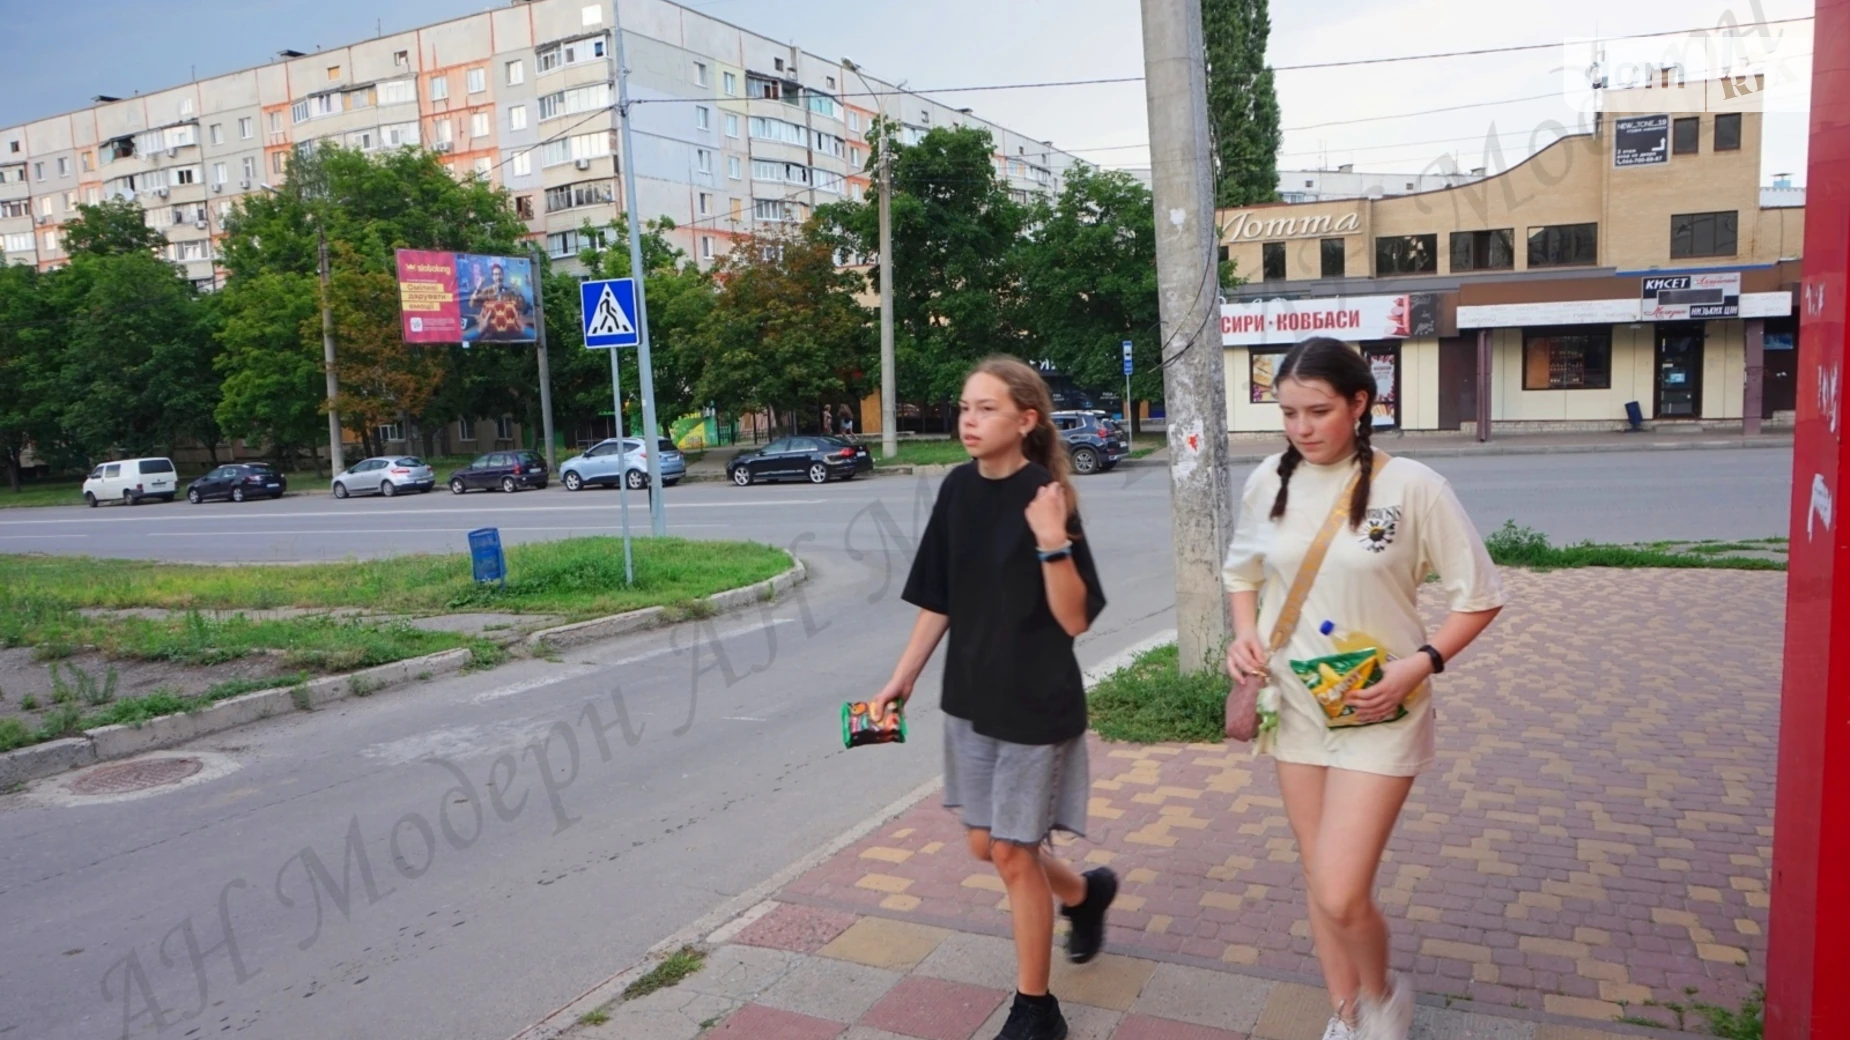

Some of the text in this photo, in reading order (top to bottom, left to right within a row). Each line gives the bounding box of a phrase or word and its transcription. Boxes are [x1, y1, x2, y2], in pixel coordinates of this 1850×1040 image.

[1645, 277, 1688, 290] КИСЕТ
[1691, 306, 1722, 316] НИЗЬКИХ
[1221, 309, 1361, 334] СИРИ КОВБАСИ
